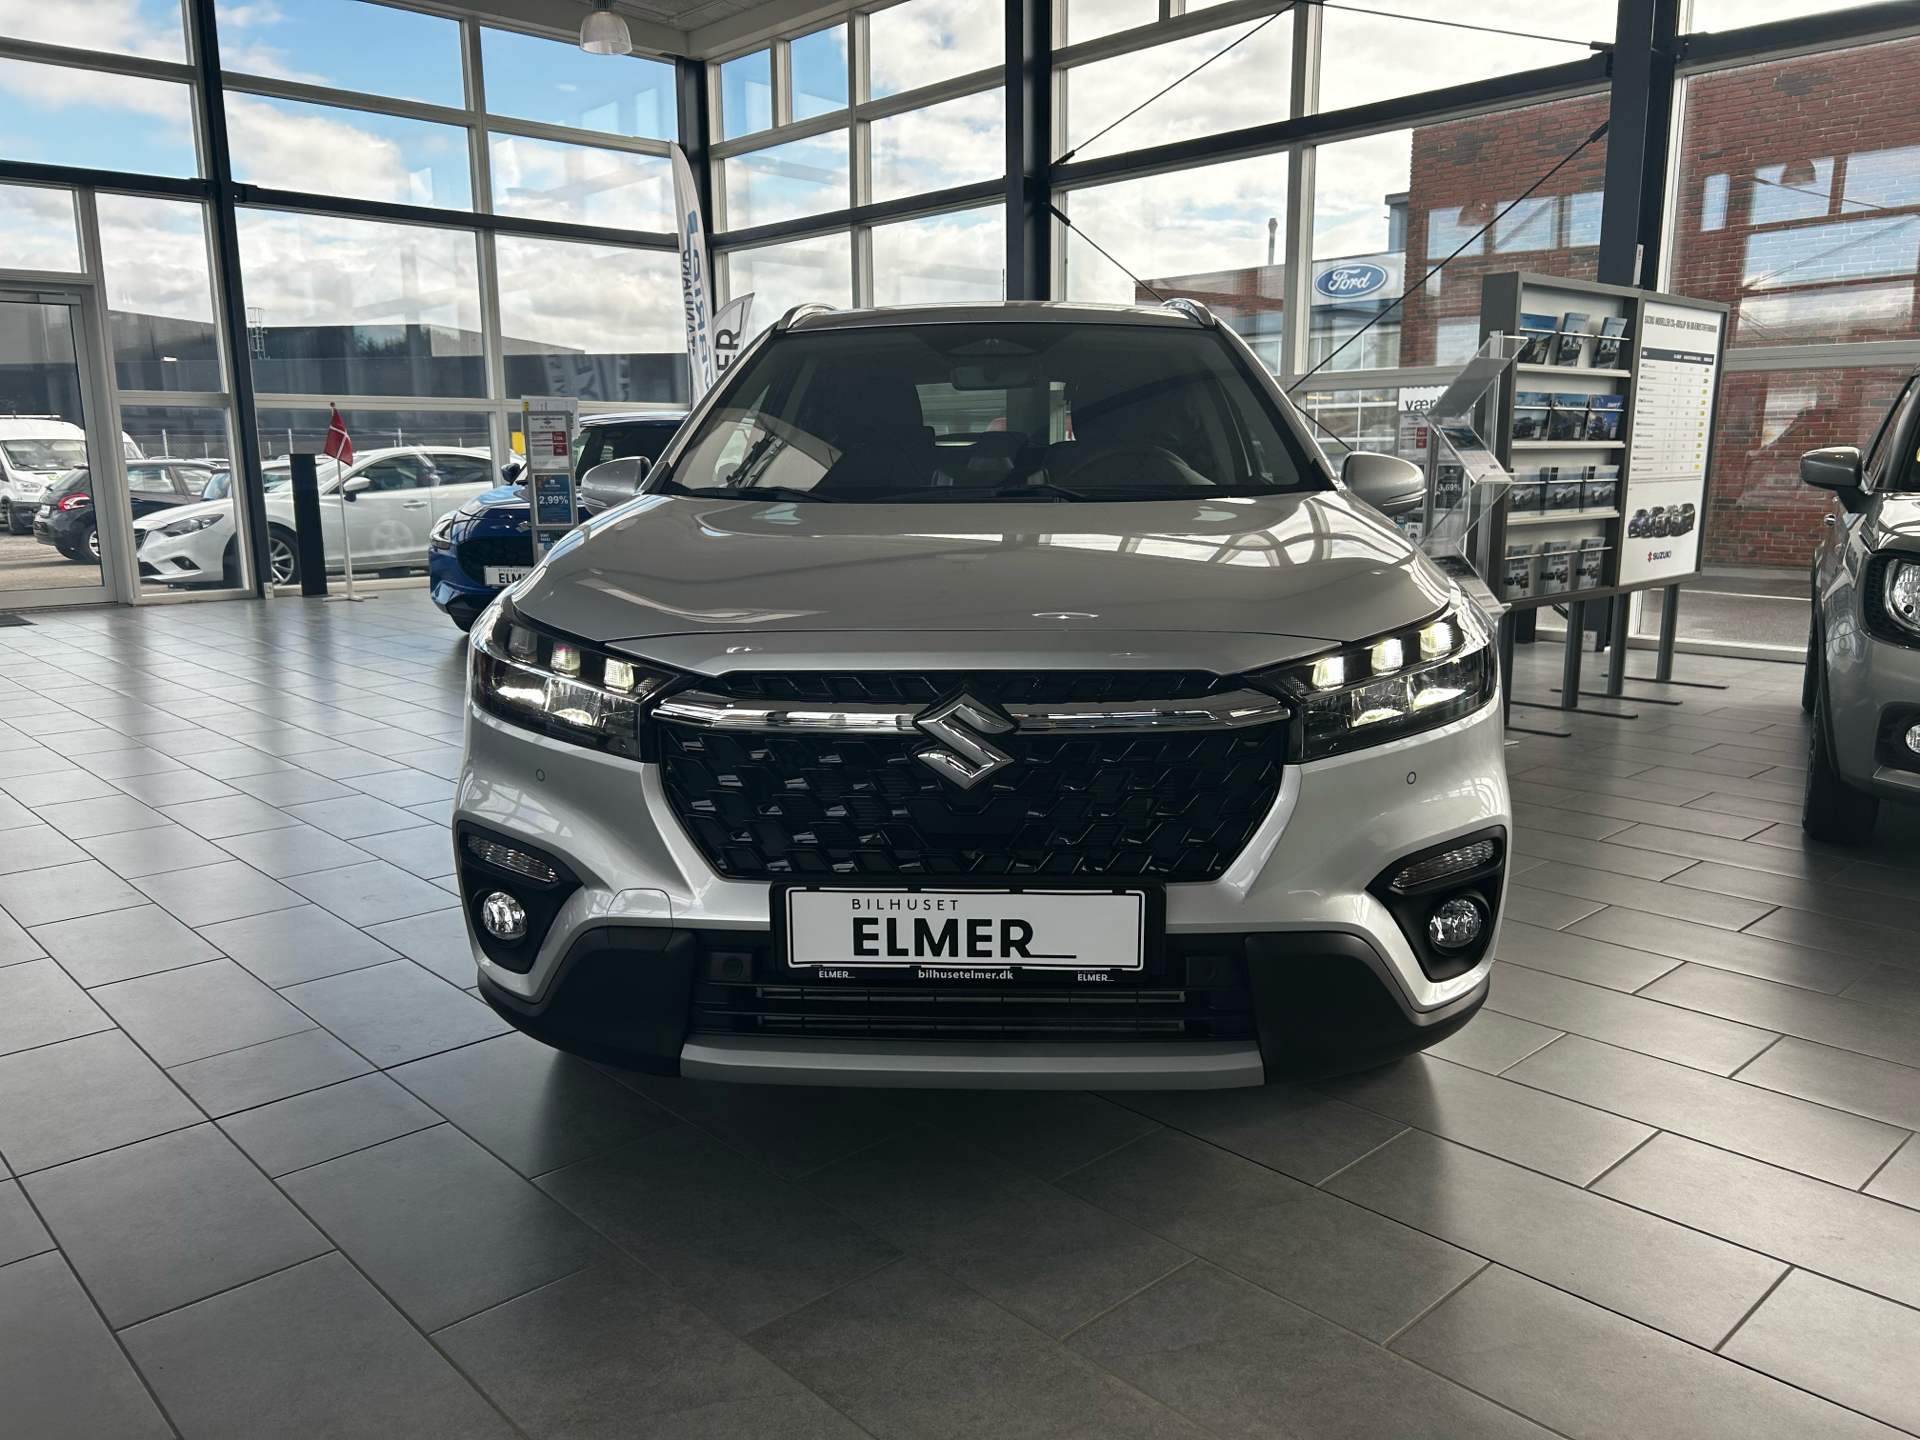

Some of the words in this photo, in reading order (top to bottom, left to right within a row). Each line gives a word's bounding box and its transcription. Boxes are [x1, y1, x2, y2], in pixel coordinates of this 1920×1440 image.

[1328, 268, 1372, 291] Ford
[1438, 483, 1462, 492] 3,69%
[539, 495, 569, 505] 2,99%
[1653, 550, 1671, 560] SUZUKI
[499, 573, 526, 584] ELM
[851, 898, 960, 911] BILHUSET
[852, 917, 1035, 959] ELMER
[819, 970, 850, 979] ELMER
[917, 969, 1014, 981] bilhusetelmer.dk
[1077, 973, 1109, 982] ELMER
